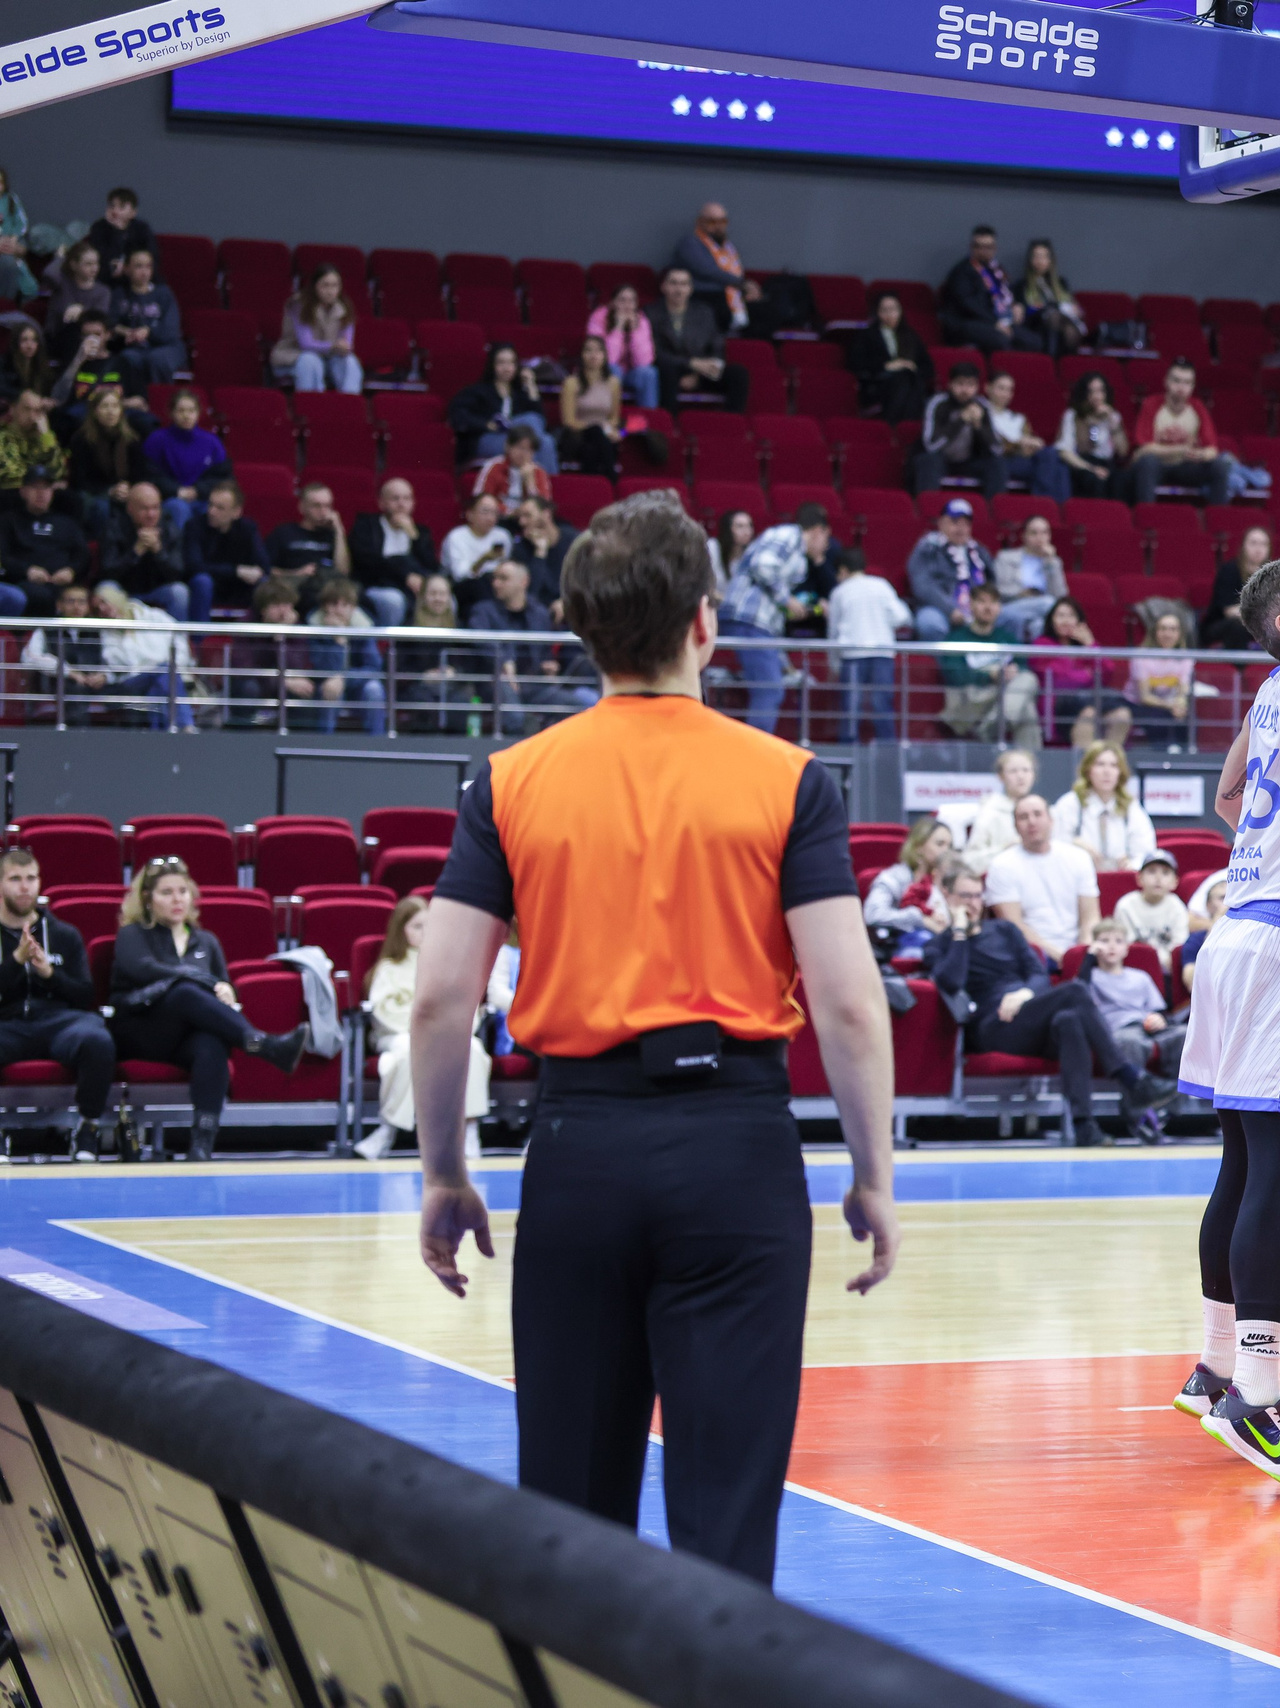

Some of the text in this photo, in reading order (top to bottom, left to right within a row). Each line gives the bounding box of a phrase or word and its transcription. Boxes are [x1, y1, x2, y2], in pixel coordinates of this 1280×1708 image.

[0, 7, 226, 86] elde Sports
[136, 30, 231, 63] Superior by Design
[938, 5, 1100, 51] Schelde
[935, 33, 1096, 78] Sports
[1246, 1333, 1276, 1342] NIKE
